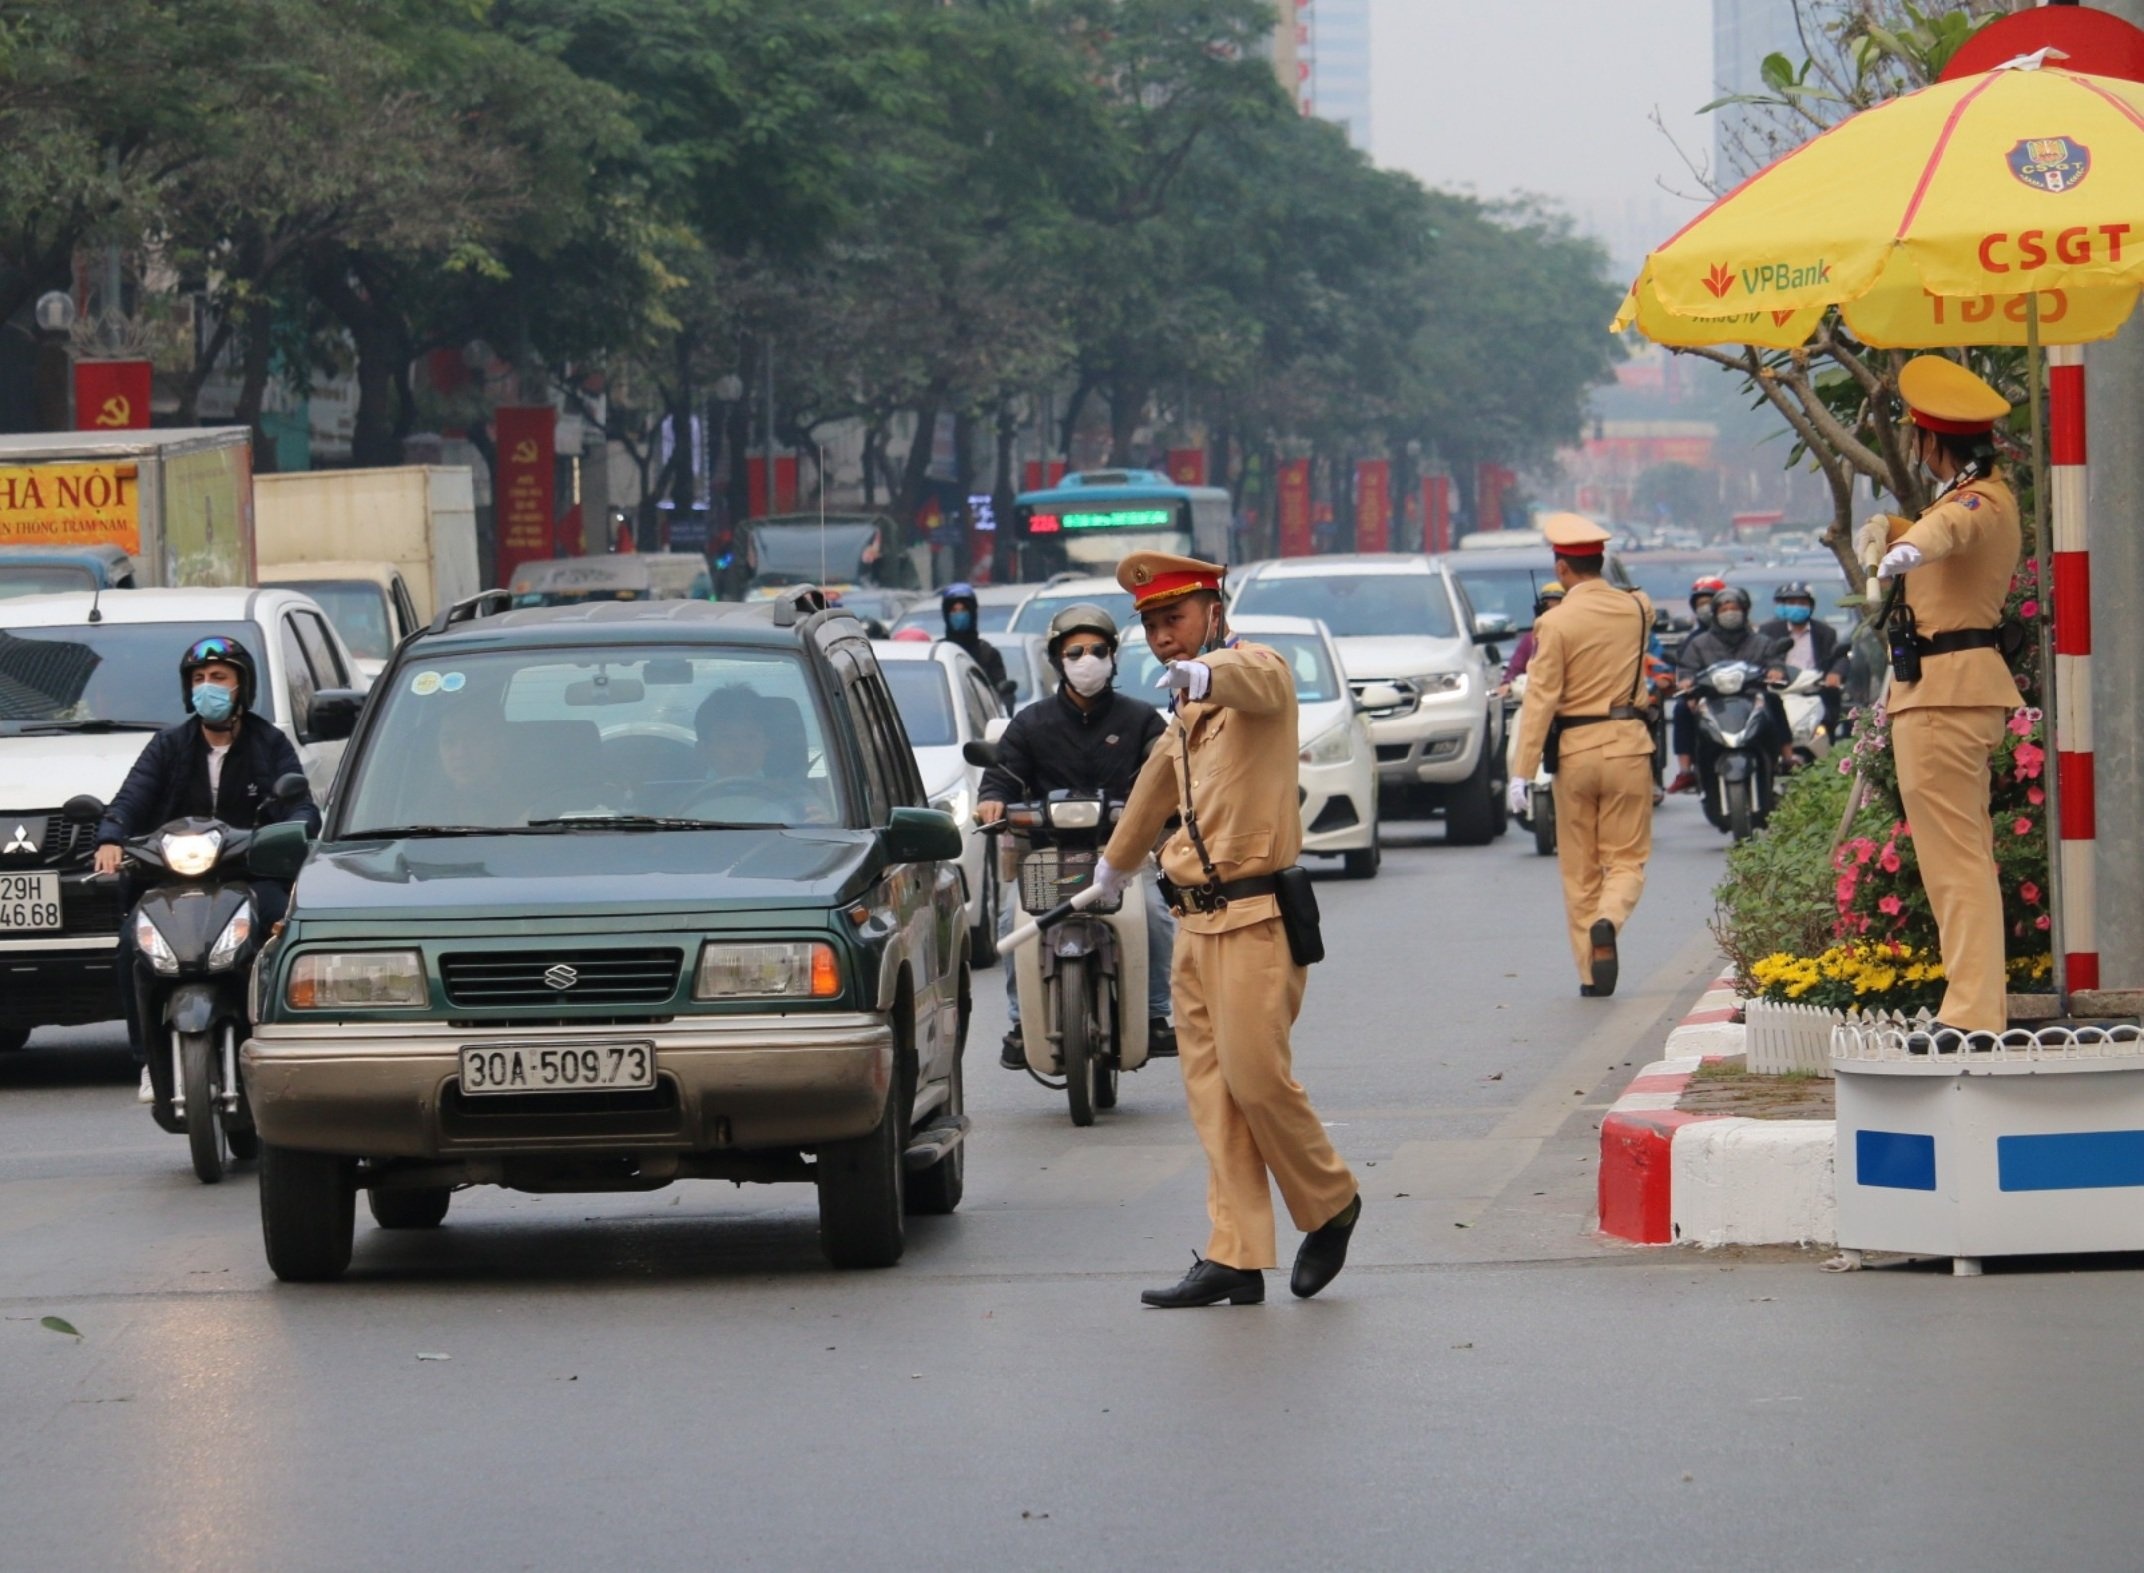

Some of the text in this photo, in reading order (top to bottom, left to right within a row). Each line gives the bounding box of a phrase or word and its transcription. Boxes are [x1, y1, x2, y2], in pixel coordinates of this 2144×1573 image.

[2022, 161, 2084, 175] CSGT
[1978, 223, 2131, 274] CSGT
[1741, 259, 1832, 295] VPBank
[56, 467, 127, 515] NỘI
[1, 876, 42, 900] 29H
[468, 1047, 647, 1087] 30A-509.73
